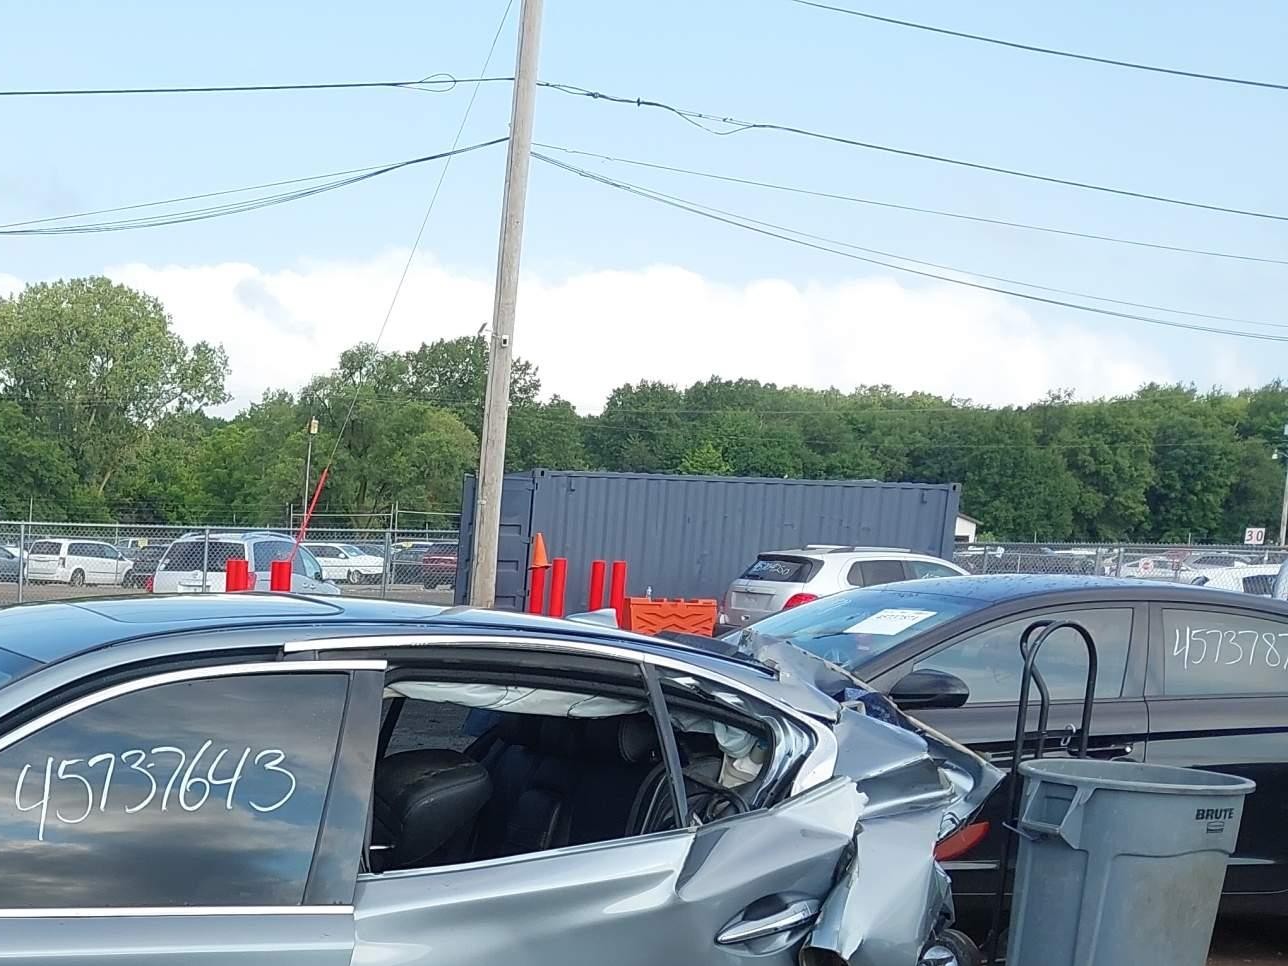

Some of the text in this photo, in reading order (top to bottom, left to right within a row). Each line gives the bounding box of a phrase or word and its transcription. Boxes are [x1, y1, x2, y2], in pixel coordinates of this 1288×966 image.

[1246, 530, 1264, 542] 30
[15, 739, 297, 841] 45737643
[1195, 807, 1235, 821] BRUTE
